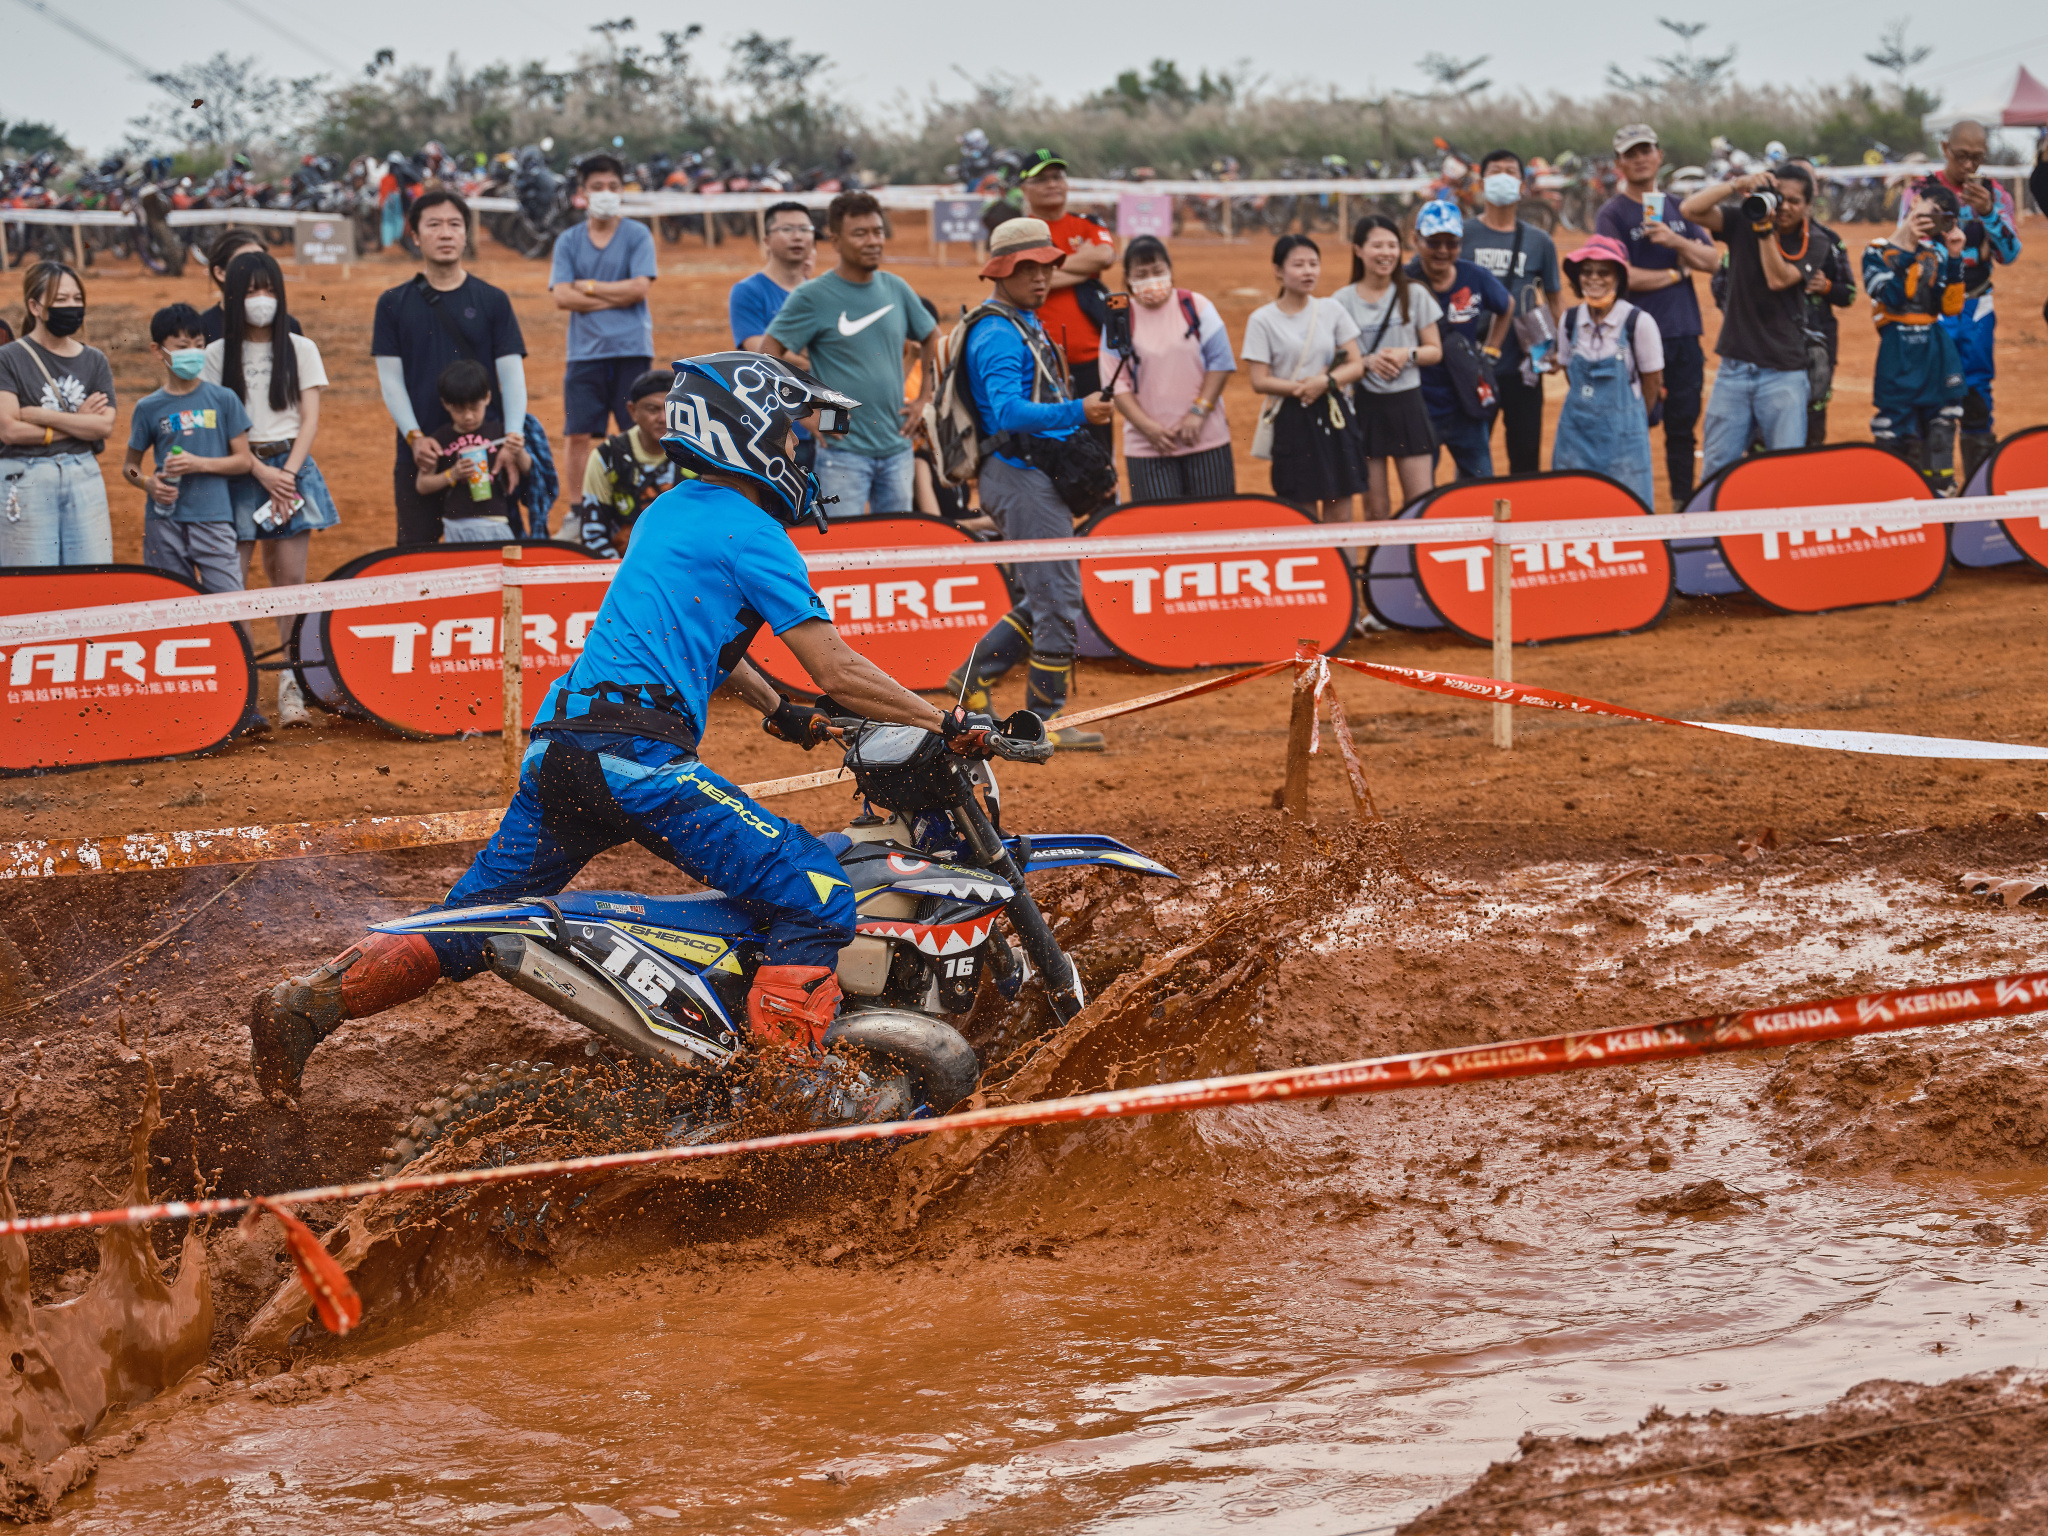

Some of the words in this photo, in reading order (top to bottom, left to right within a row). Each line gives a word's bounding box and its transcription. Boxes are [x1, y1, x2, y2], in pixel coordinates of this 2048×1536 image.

[1093, 556, 1325, 614] TARC
[0, 638, 216, 686] ARC
[1033, 848, 1085, 858] ACERBIS
[628, 924, 721, 953] SHERCO
[601, 934, 676, 1006] 16
[944, 957, 975, 979] 16
[1753, 1006, 1841, 1033] KENDA
[1898, 988, 1980, 1015] KENDA
